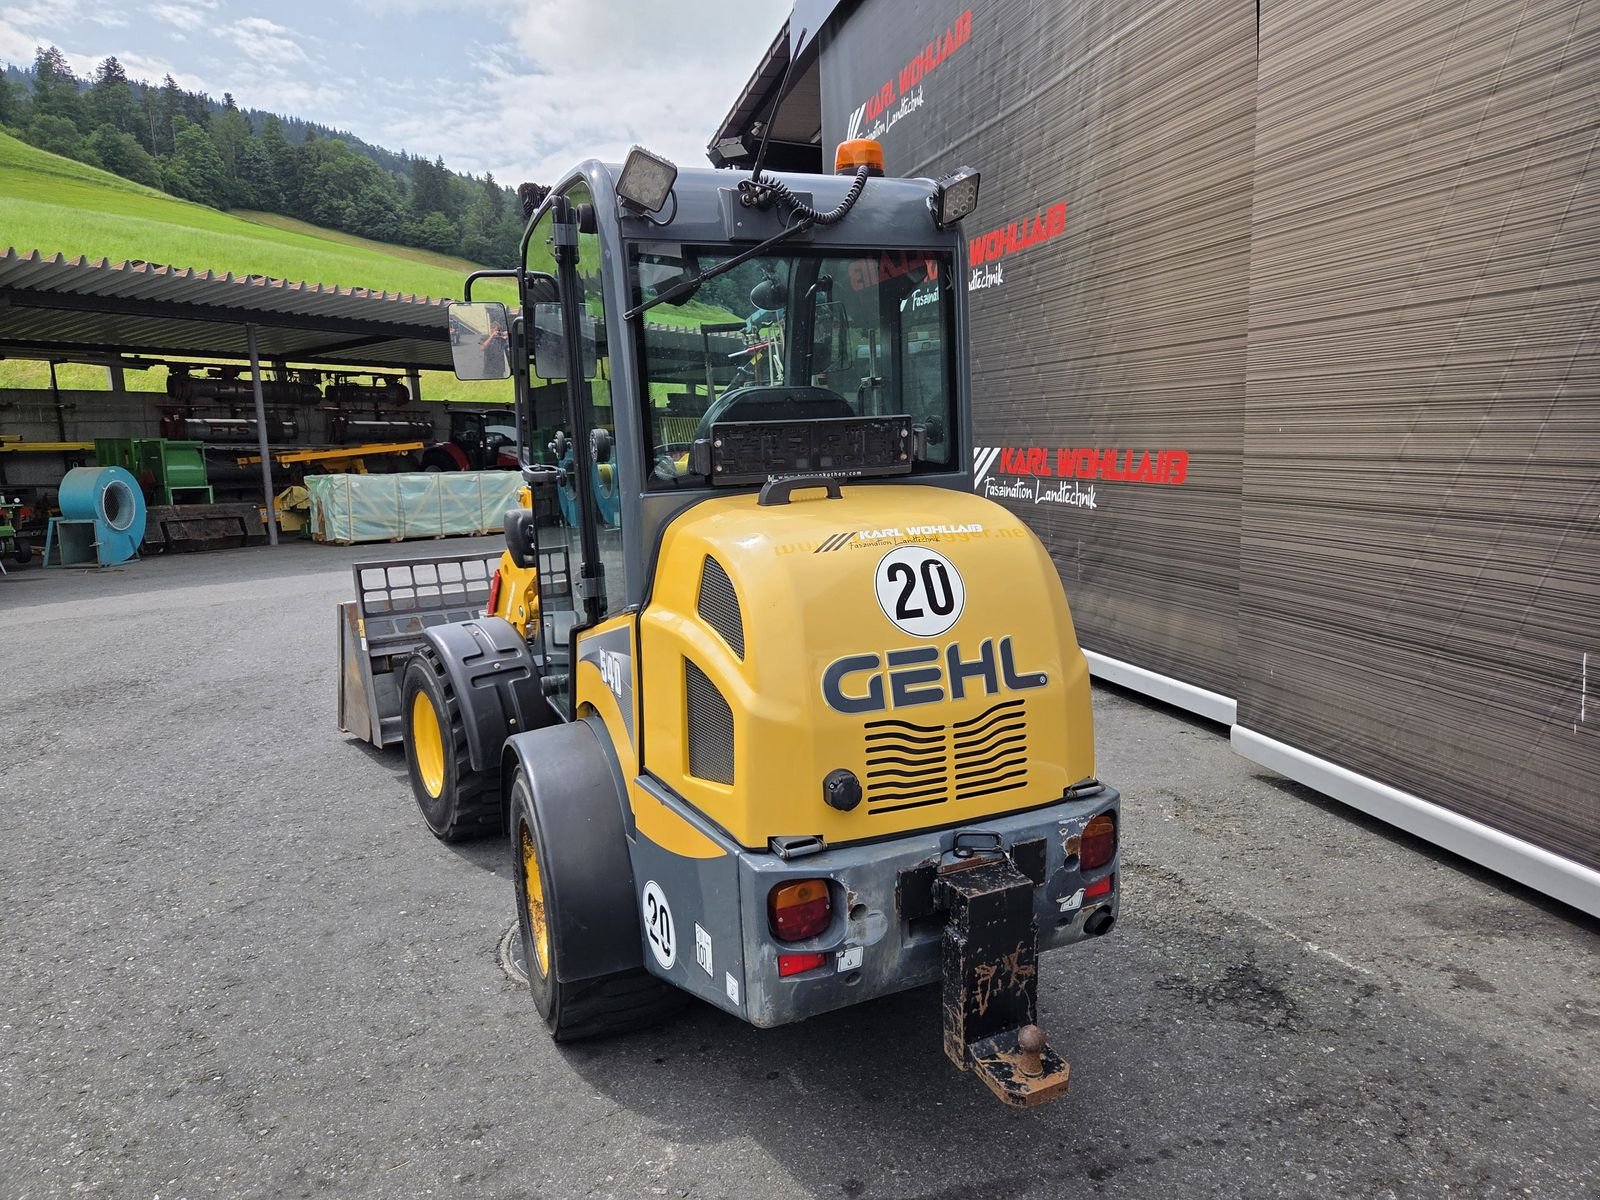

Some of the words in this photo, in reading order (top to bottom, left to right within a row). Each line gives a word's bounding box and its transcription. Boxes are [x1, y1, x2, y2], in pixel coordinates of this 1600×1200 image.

[865, 79, 896, 125] KARL
[1000, 447, 1052, 477] KARL
[984, 475, 1033, 499] Faszination
[1035, 479, 1097, 509] Landtechnik
[848, 538, 893, 551] Faszination
[894, 534, 941, 546] Landtechnik
[859, 528, 905, 541] KARL
[886, 558, 955, 621] 20
[820, 634, 1049, 715] GEHL
[647, 891, 671, 958] 20
